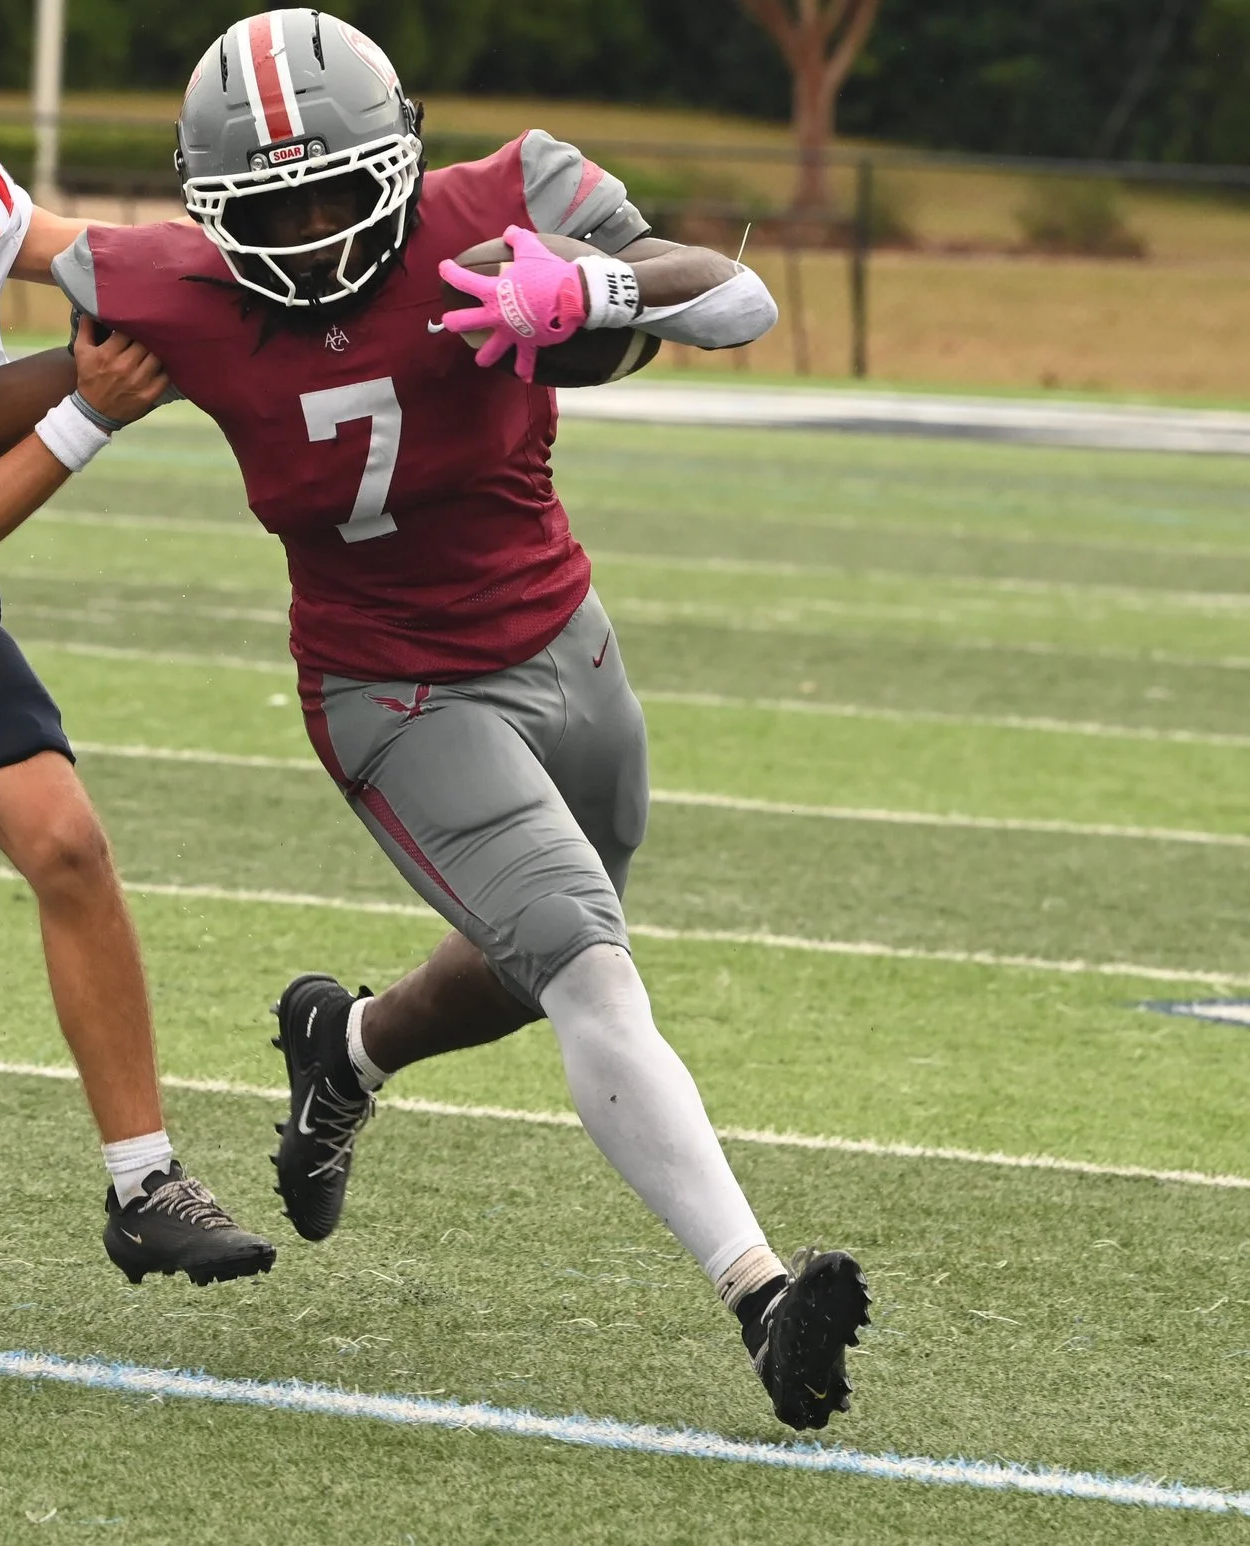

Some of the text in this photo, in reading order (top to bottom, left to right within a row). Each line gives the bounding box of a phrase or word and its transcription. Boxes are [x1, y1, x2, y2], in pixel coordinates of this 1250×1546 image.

[273, 147, 302, 161] SOAR
[605, 272, 619, 306] PHIL
[620, 274, 636, 309] 4:13
[299, 376, 402, 544] 7
